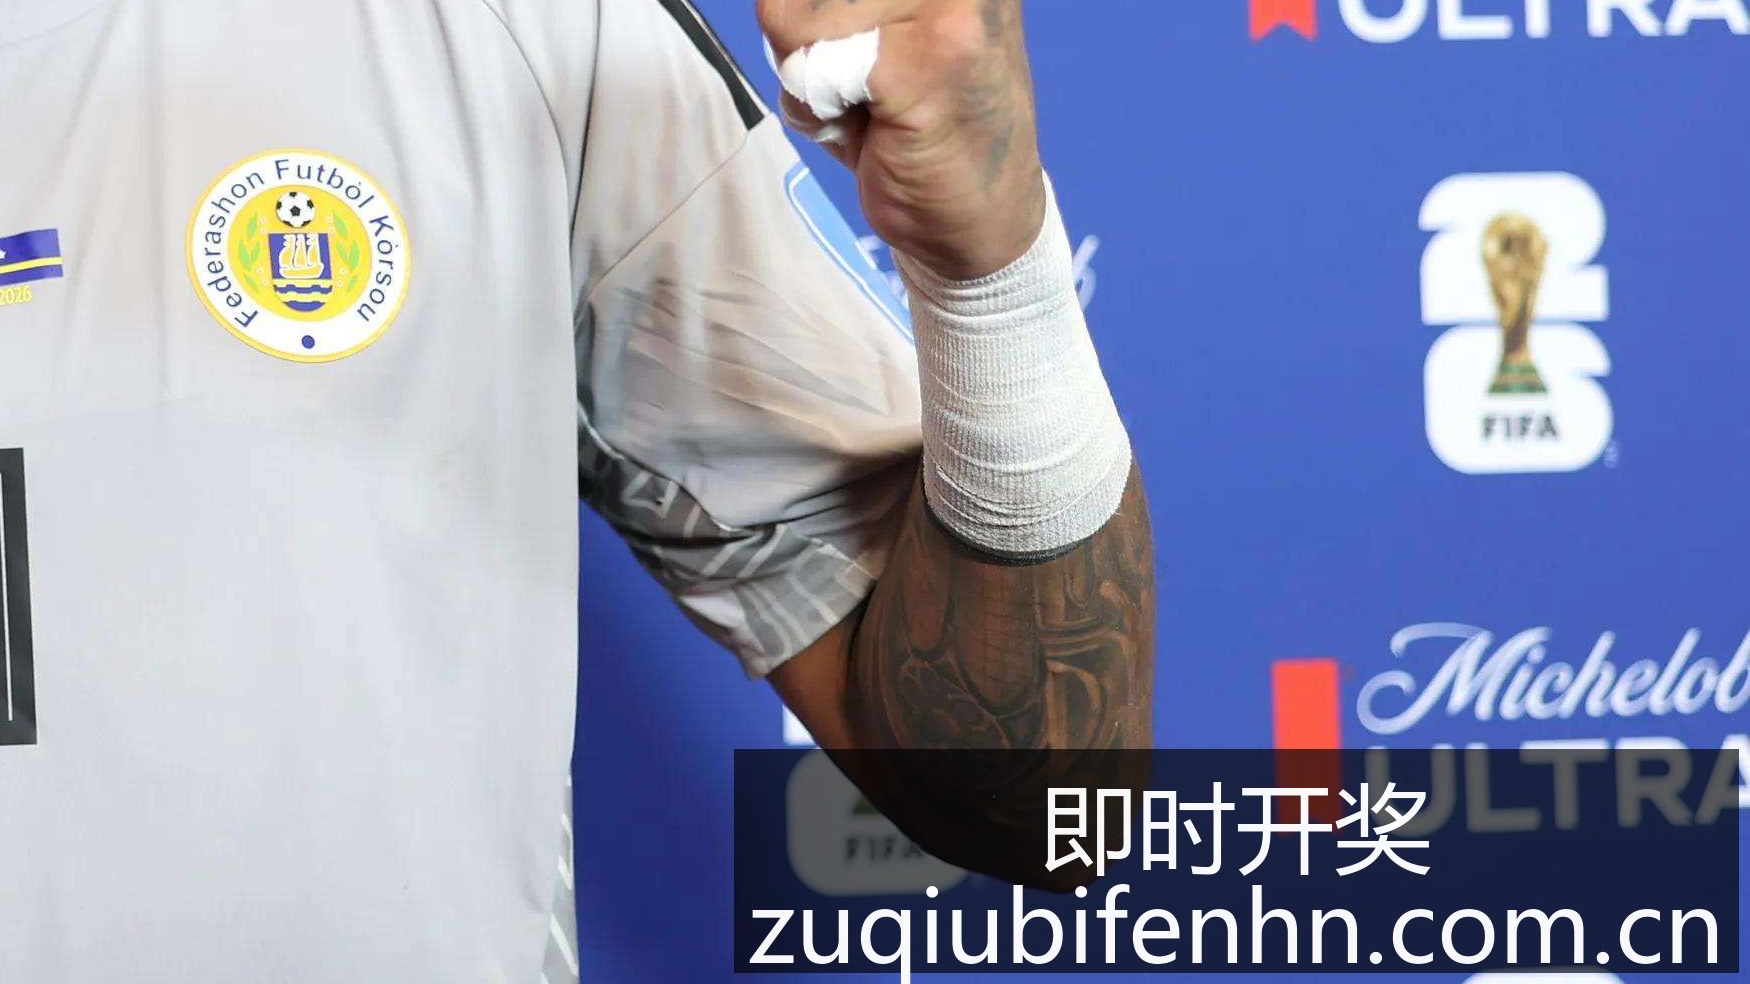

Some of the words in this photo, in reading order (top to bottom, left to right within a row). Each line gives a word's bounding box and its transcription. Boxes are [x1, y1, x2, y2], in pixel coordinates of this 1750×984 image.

[204, 171, 265, 328] Federashon
[1481, 411, 1560, 442] FIFA
[1357, 623, 1750, 740] Michelob
